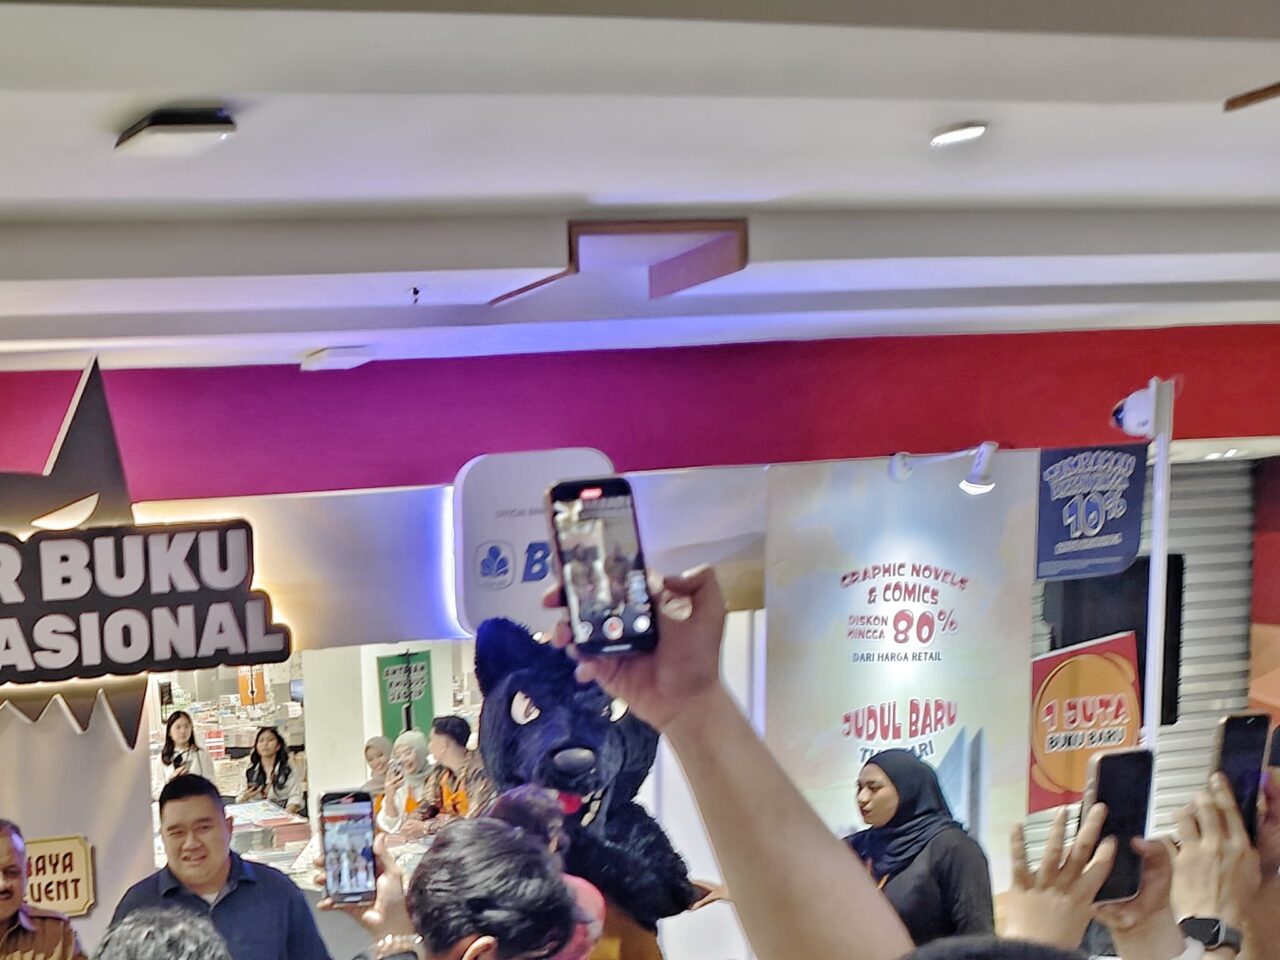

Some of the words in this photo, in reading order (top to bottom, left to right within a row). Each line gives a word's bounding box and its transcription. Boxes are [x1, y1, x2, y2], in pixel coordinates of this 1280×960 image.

[38, 528, 250, 602] BUKU
[522, 541, 552, 583] B
[882, 580, 941, 606] COMICS
[848, 614, 889, 627] DISKON
[847, 628, 886, 640] HINGGA
[852, 651, 875, 663] DARI
[877, 651, 910, 663] HARGA
[911, 651, 943, 662] RETAIL
[841, 700, 903, 742] JUDUL
[907, 698, 959, 740] BARU
